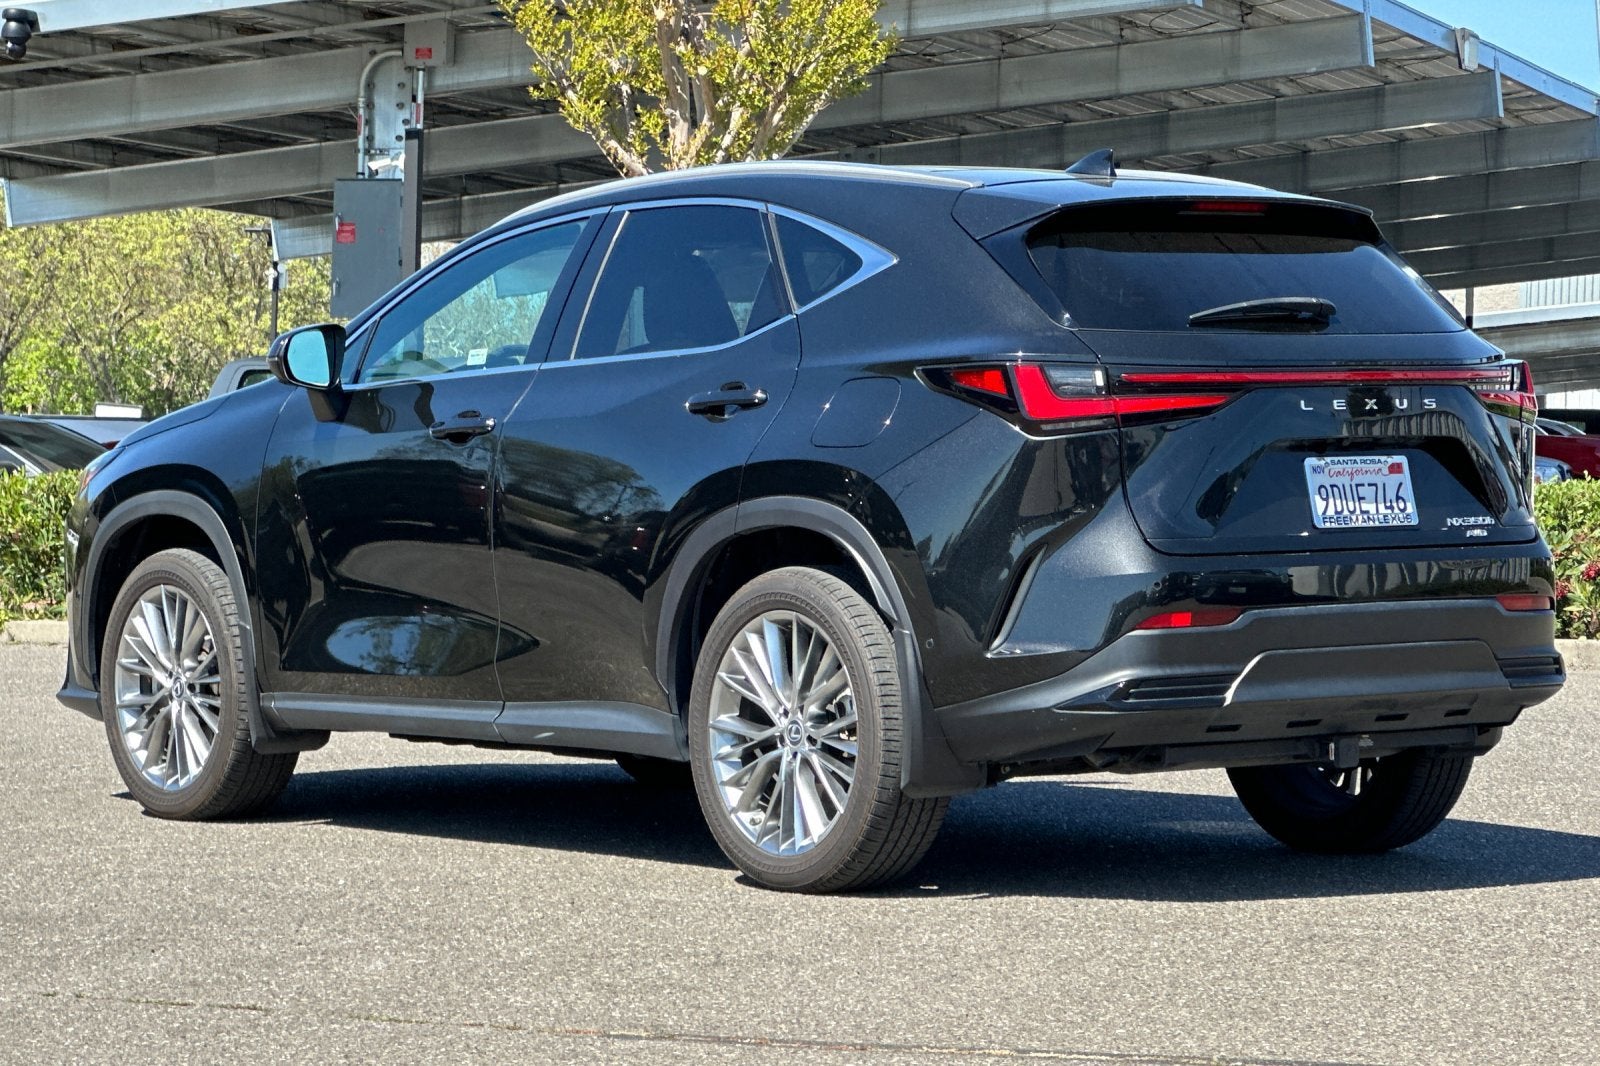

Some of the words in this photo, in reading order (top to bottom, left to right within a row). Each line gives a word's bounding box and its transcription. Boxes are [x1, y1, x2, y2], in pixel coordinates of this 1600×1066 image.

[1300, 398, 1437, 410] LEXUS
[1330, 458, 1358, 466] SANTA
[1312, 465, 1325, 474] NOV
[1329, 467, 1388, 481] California
[1318, 482, 1408, 516] 9DUE746
[1322, 515, 1376, 526] FREEMAN
[1377, 514, 1413, 524] LEXUS
